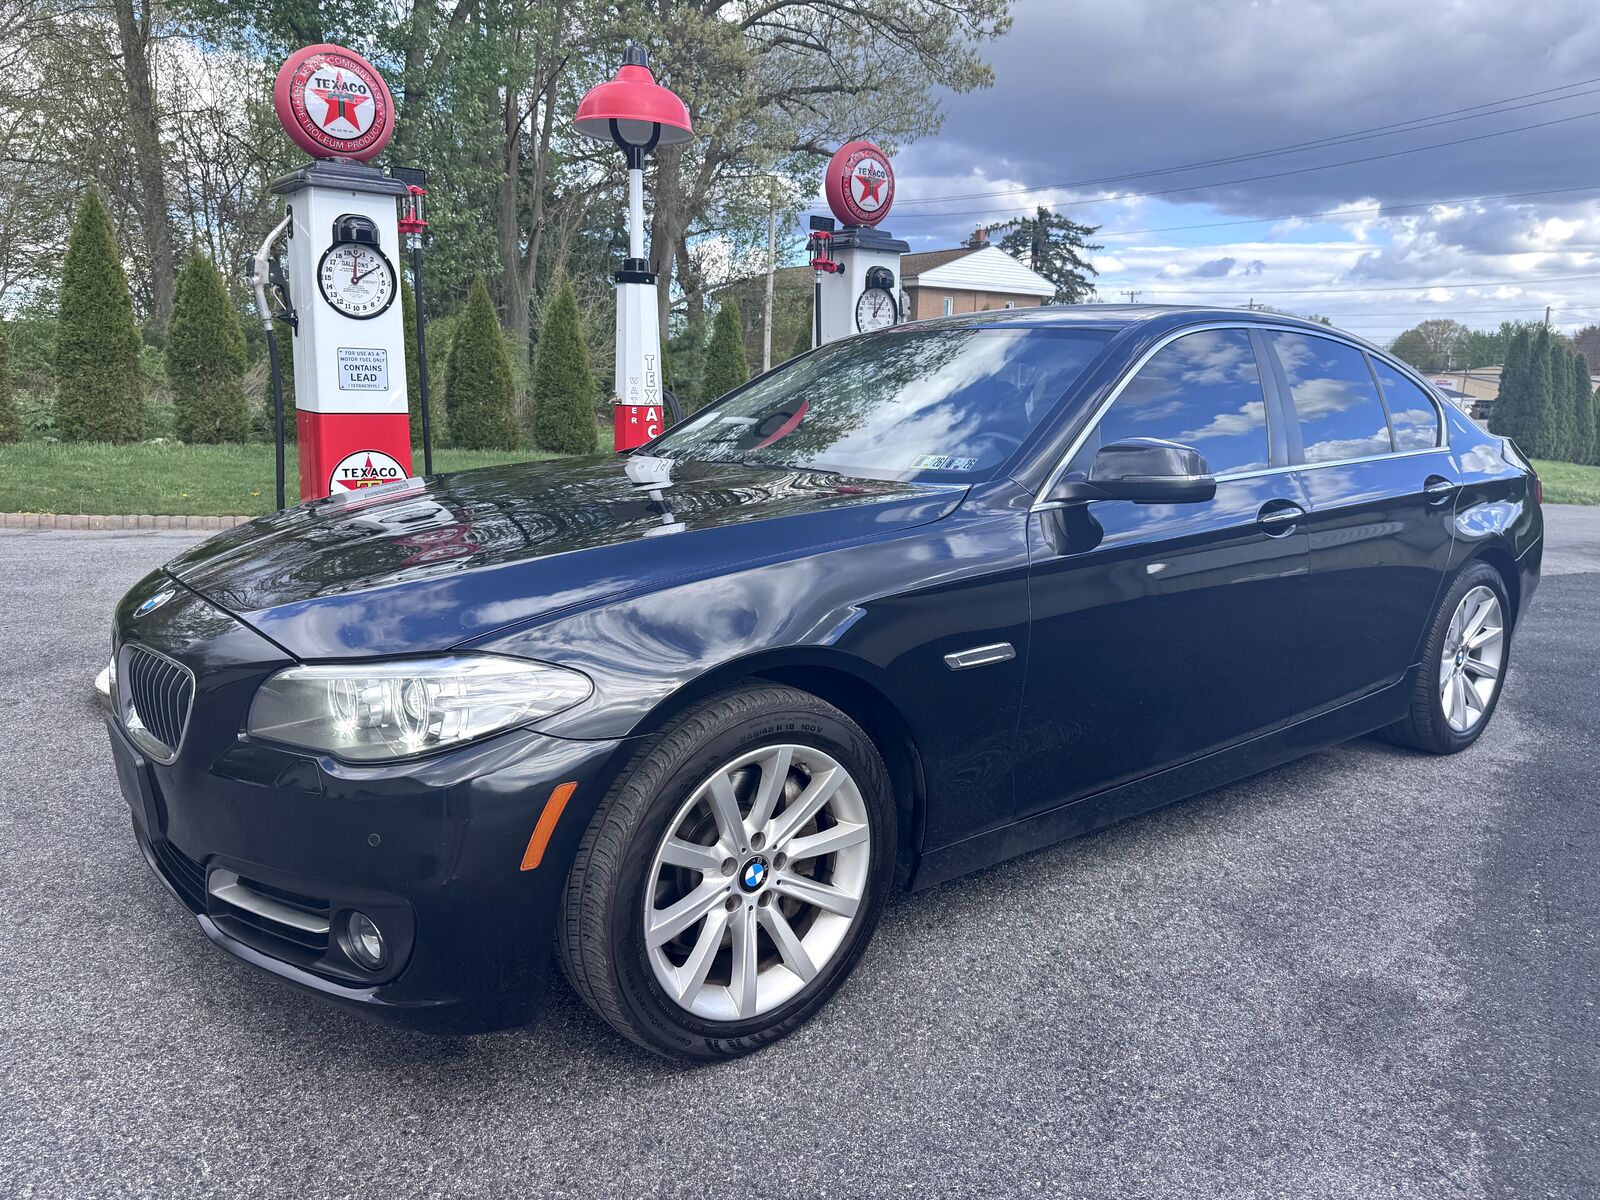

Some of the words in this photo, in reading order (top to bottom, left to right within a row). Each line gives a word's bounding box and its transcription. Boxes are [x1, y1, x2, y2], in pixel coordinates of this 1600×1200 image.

[327, 57, 371, 84] COMPANY
[314, 77, 367, 95] TEXACO
[296, 106, 344, 149] PETROLEUM
[347, 117, 383, 149] PRODUCTS
[858, 167, 886, 179] TEXACO
[343, 364, 383, 372] CONTAINS
[350, 372, 377, 382] LEAD
[629, 376, 639, 424] WATER
[341, 467, 397, 478] TEXACO
